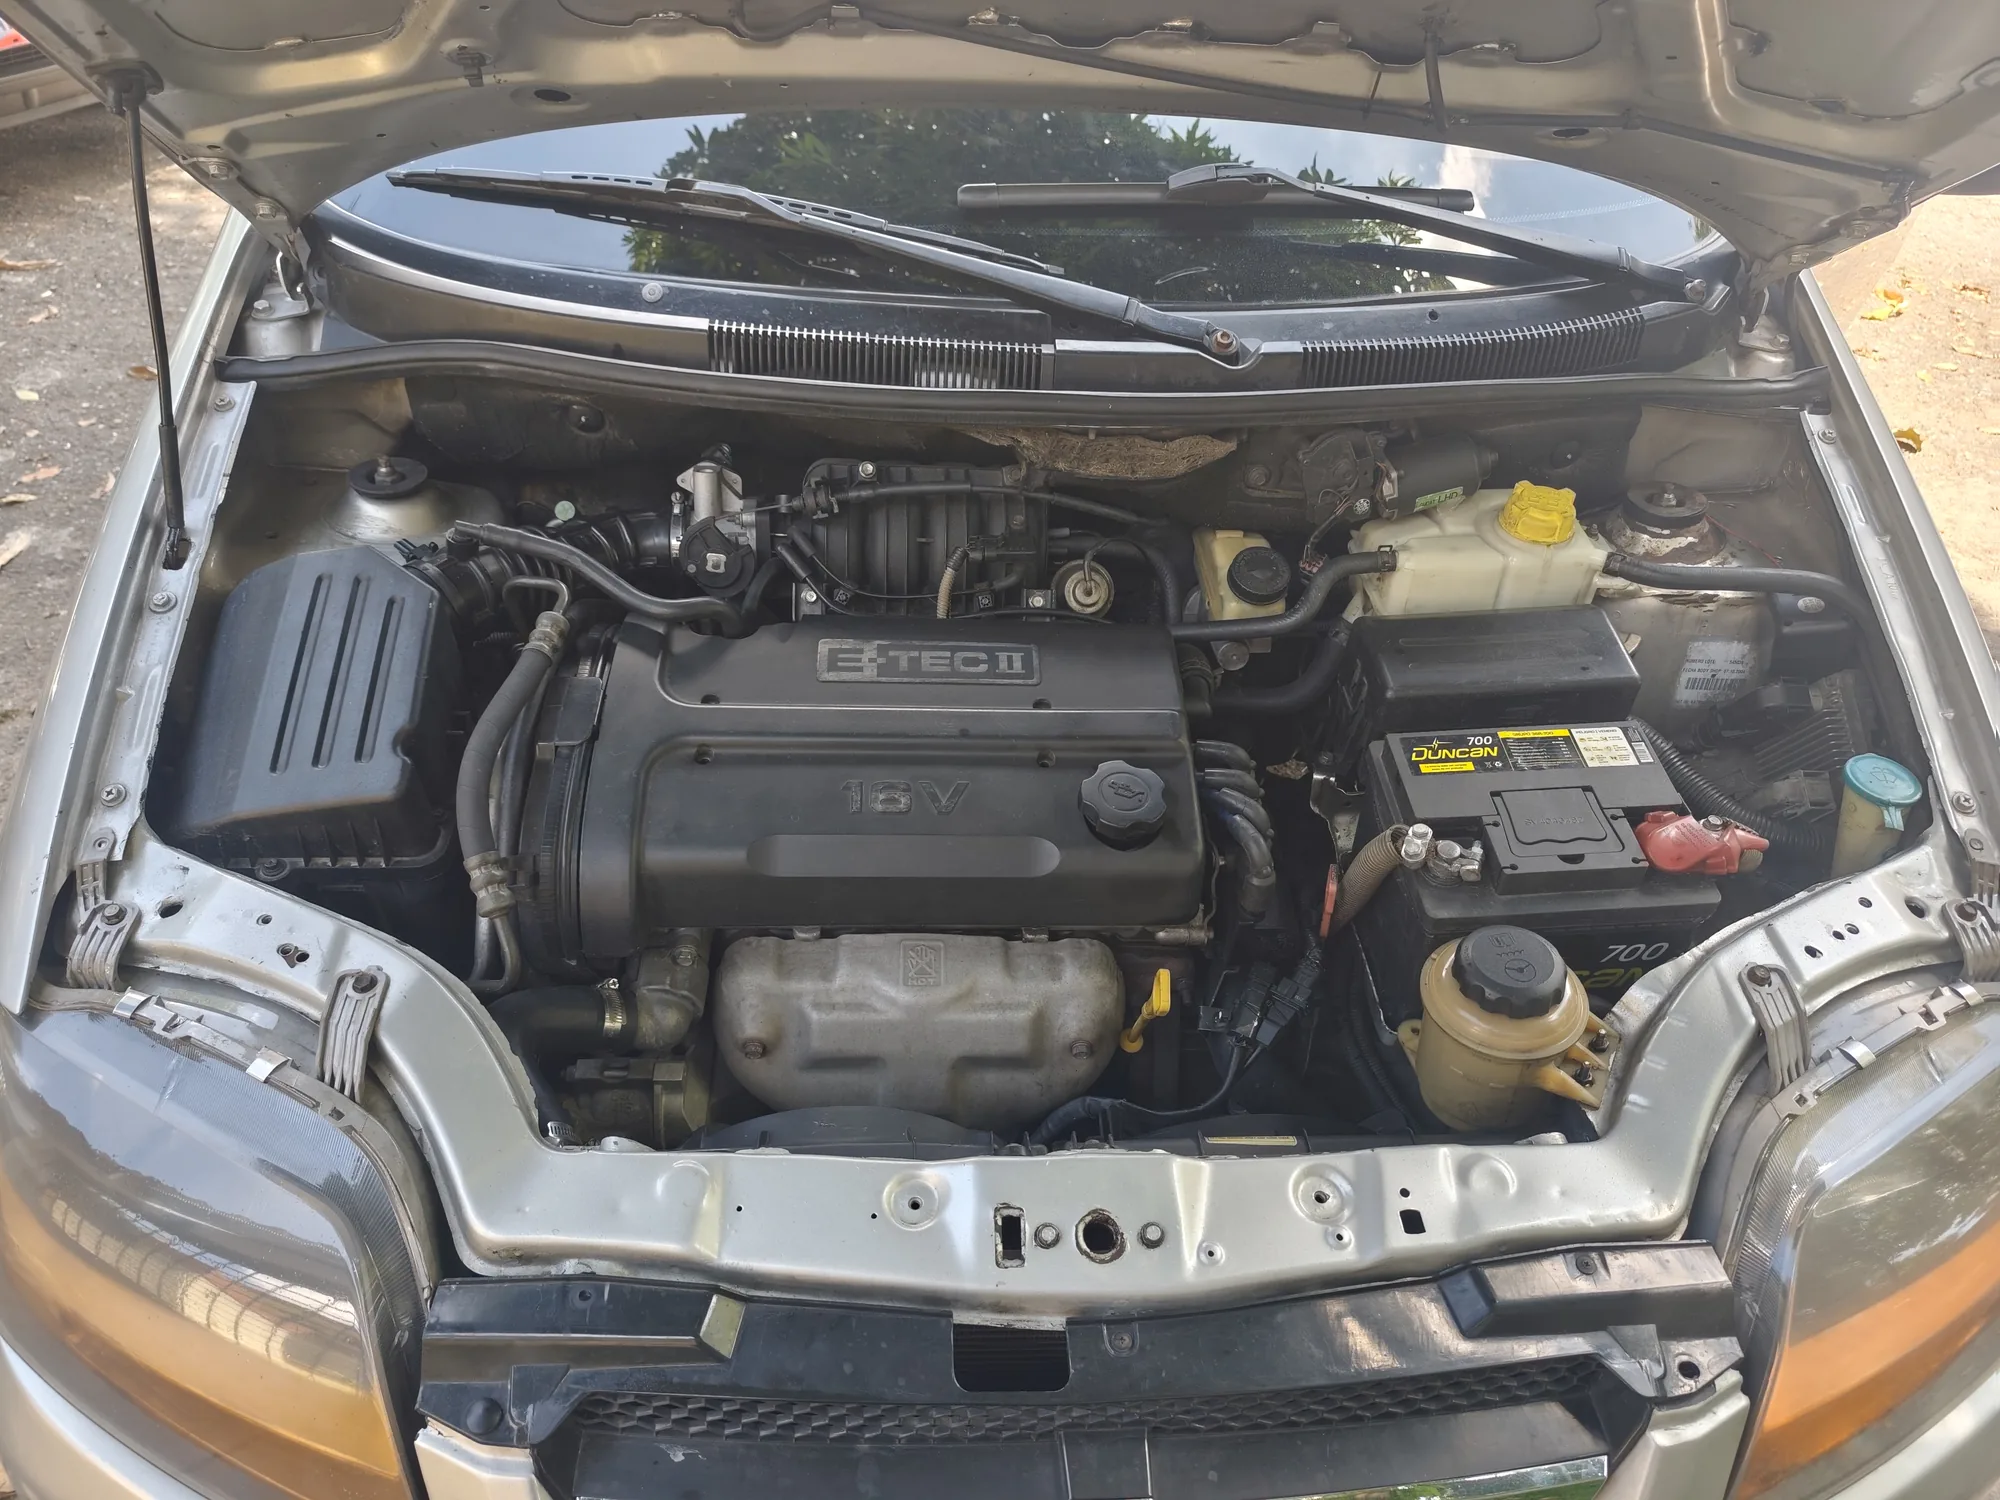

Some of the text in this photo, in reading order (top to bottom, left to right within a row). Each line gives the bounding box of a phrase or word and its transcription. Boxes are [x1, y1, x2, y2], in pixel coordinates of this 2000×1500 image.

[1466, 736, 1492, 745] 700
[1411, 746, 1498, 760] DUNCAN
[841, 780, 970, 815] 16V
[1600, 942, 1669, 962] 700
